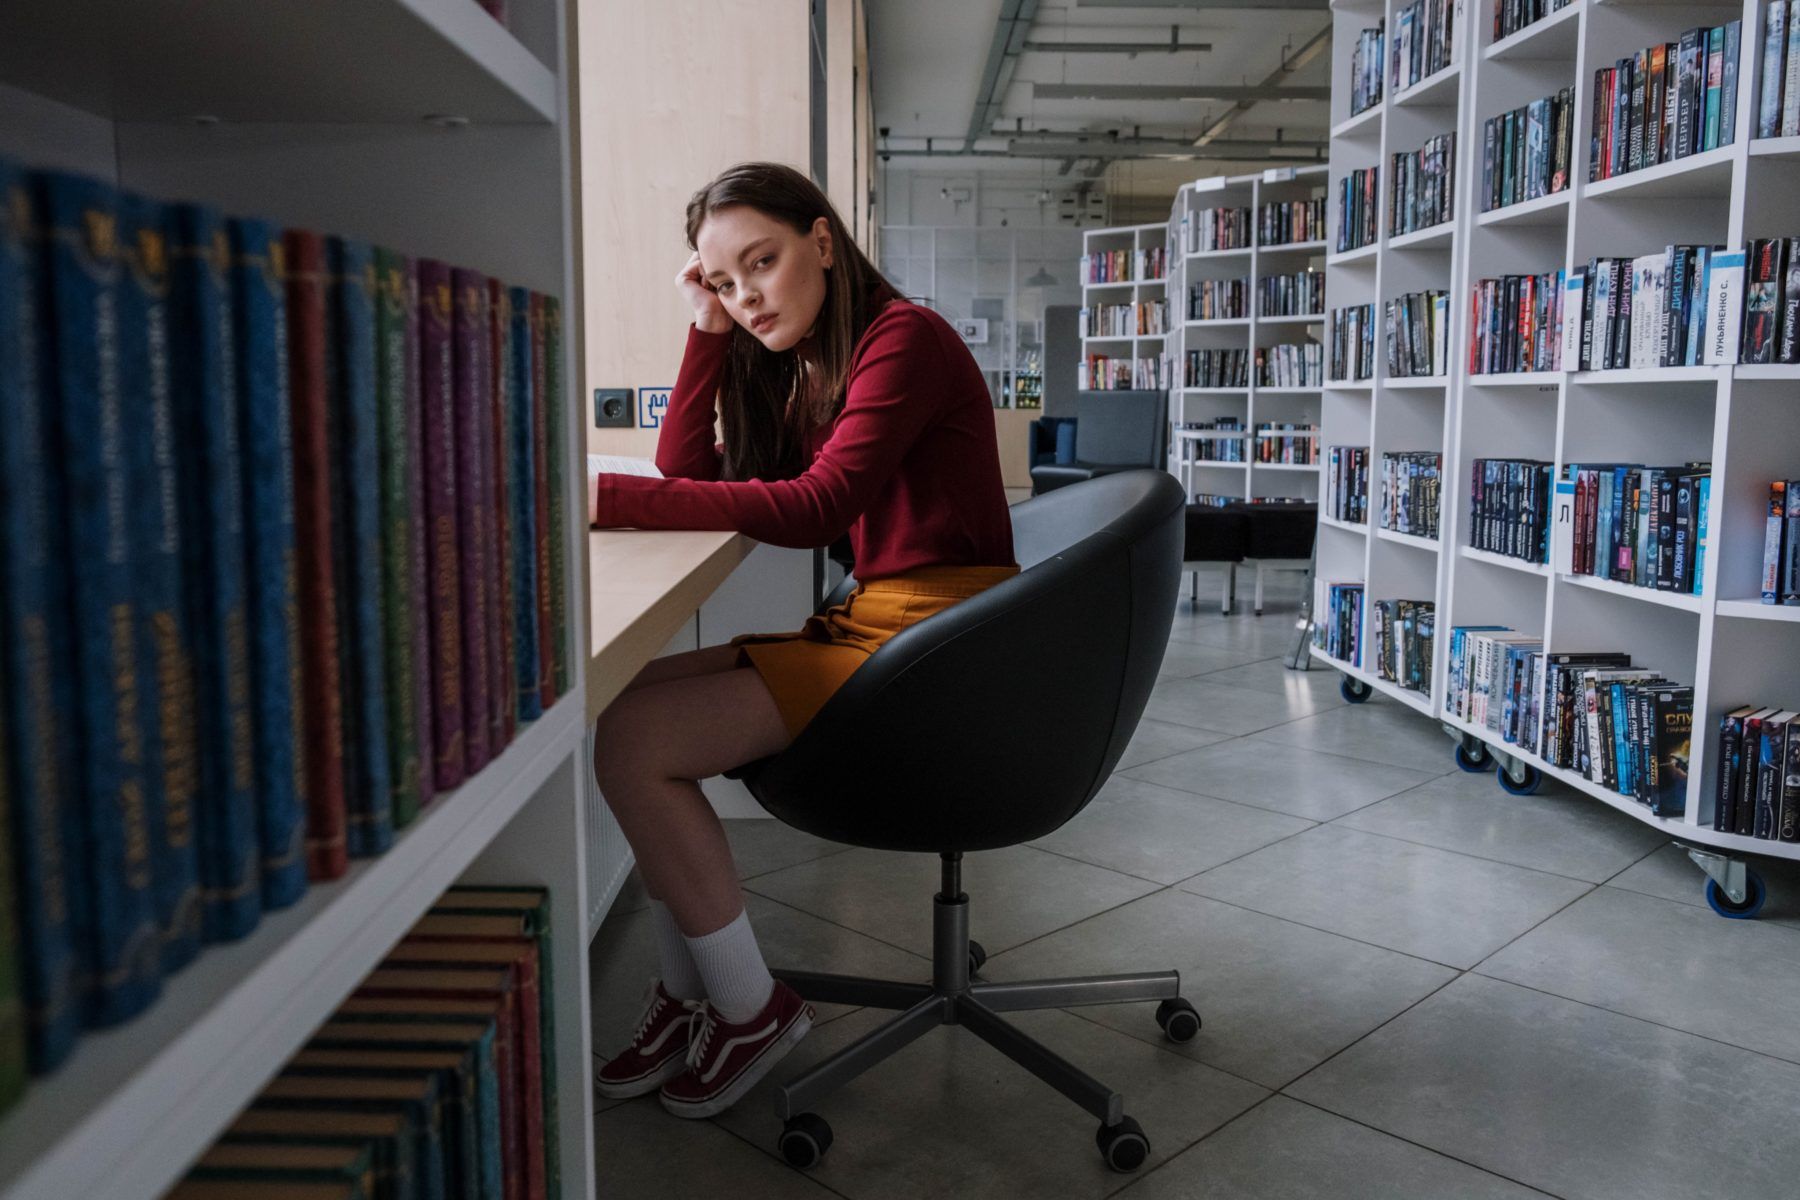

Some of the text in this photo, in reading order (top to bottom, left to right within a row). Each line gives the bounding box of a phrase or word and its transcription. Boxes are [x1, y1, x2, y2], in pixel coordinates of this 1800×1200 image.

[1667, 87, 1676, 124] ПОБЕГ
[1678, 99, 1689, 155] ЦЕРБЕР
[1608, 265, 1619, 316] ДИН КУНЦ
[1621, 262, 1632, 315] ДИН КУНЦ
[1672, 253, 1685, 310] ДИН КУНЦ
[1582, 320, 1592, 361] ДИН КУНЦ
[1660, 312, 1670, 357] ДИН КУНЦ
[1715, 280, 1728, 357] ЛУКЬЯНЕНКО С.
[1560, 505, 1568, 523] Л
[1673, 530, 1684, 578] ЛЮБОВНИК РОЗ
